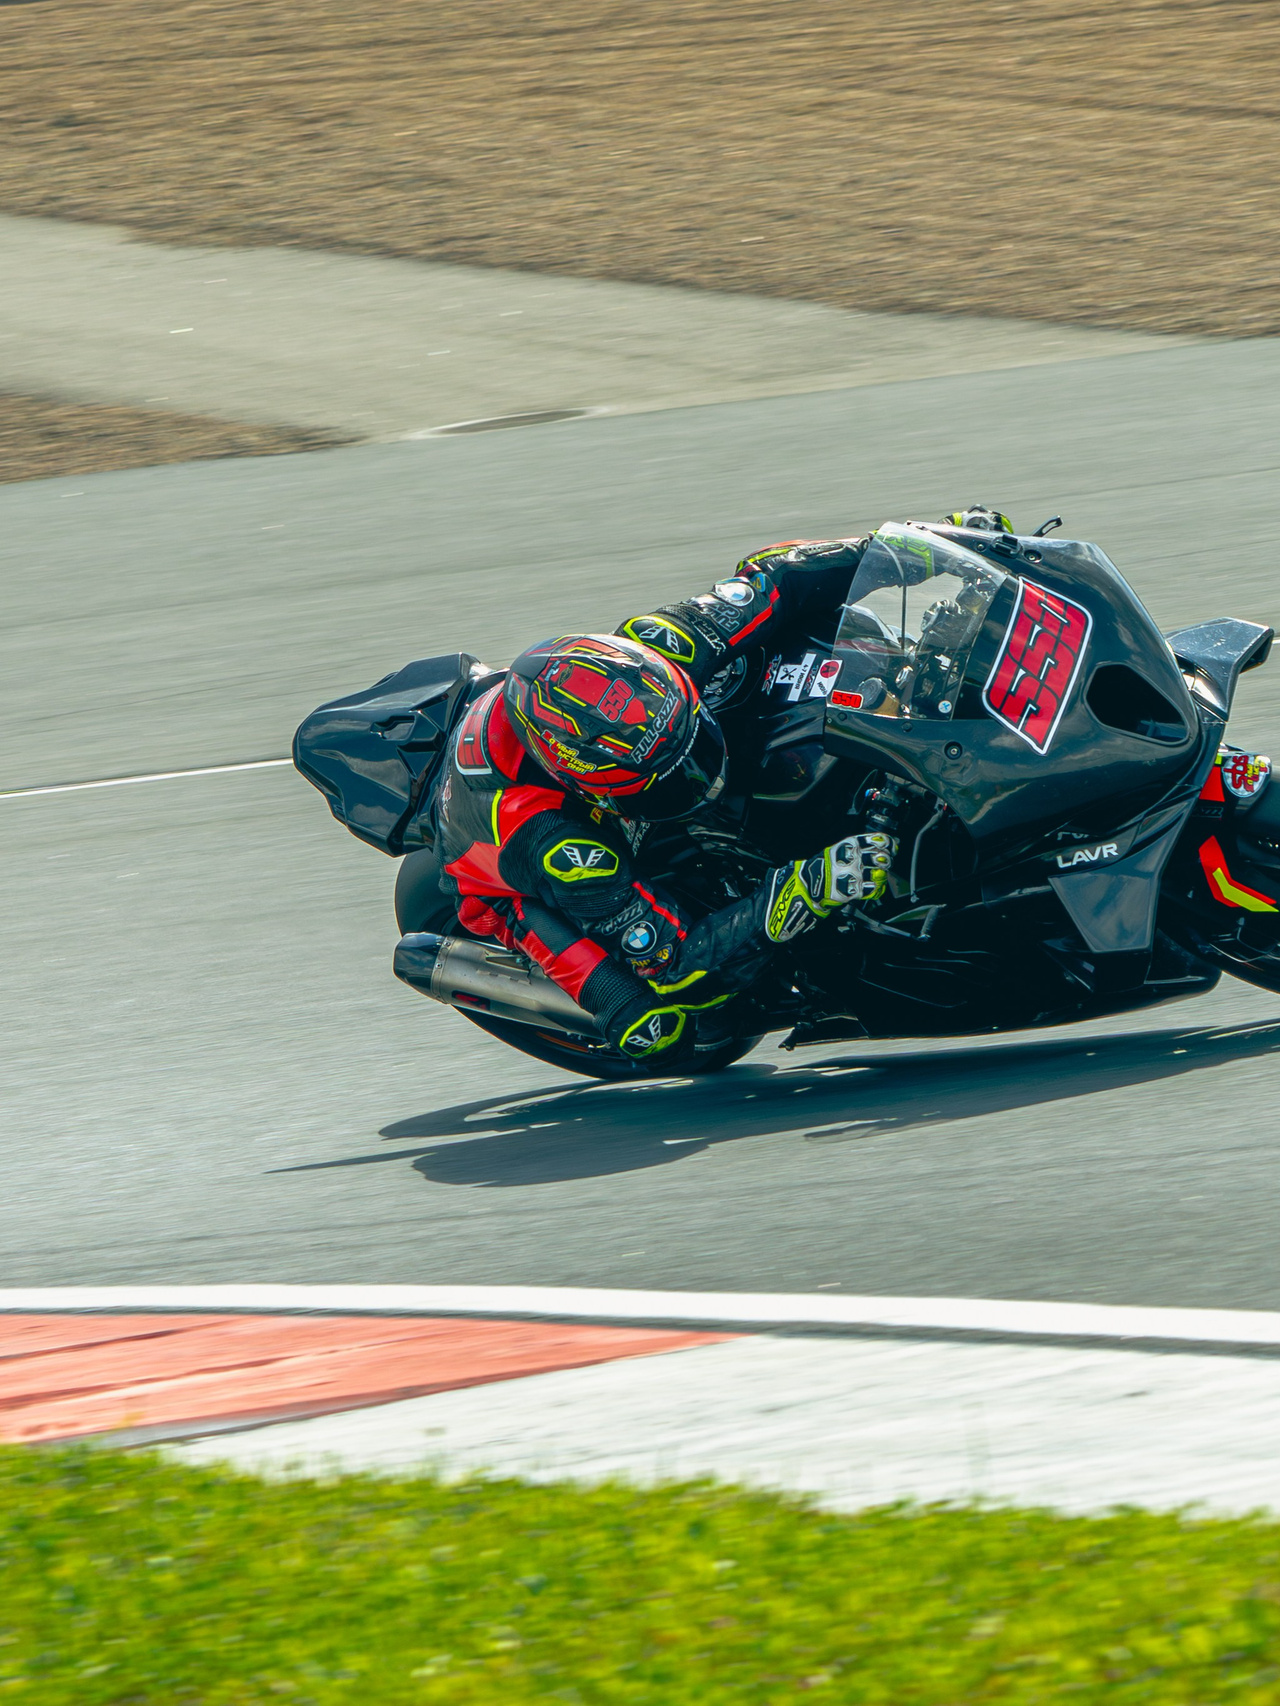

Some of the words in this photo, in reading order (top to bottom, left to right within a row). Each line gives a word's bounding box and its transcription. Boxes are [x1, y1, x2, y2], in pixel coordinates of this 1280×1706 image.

[989, 583, 1086, 745] 550
[600, 680, 634, 722] 550
[832, 691, 862, 708] 550
[631, 729, 659, 764] FULL
[1056, 842, 1119, 869] LAVR
